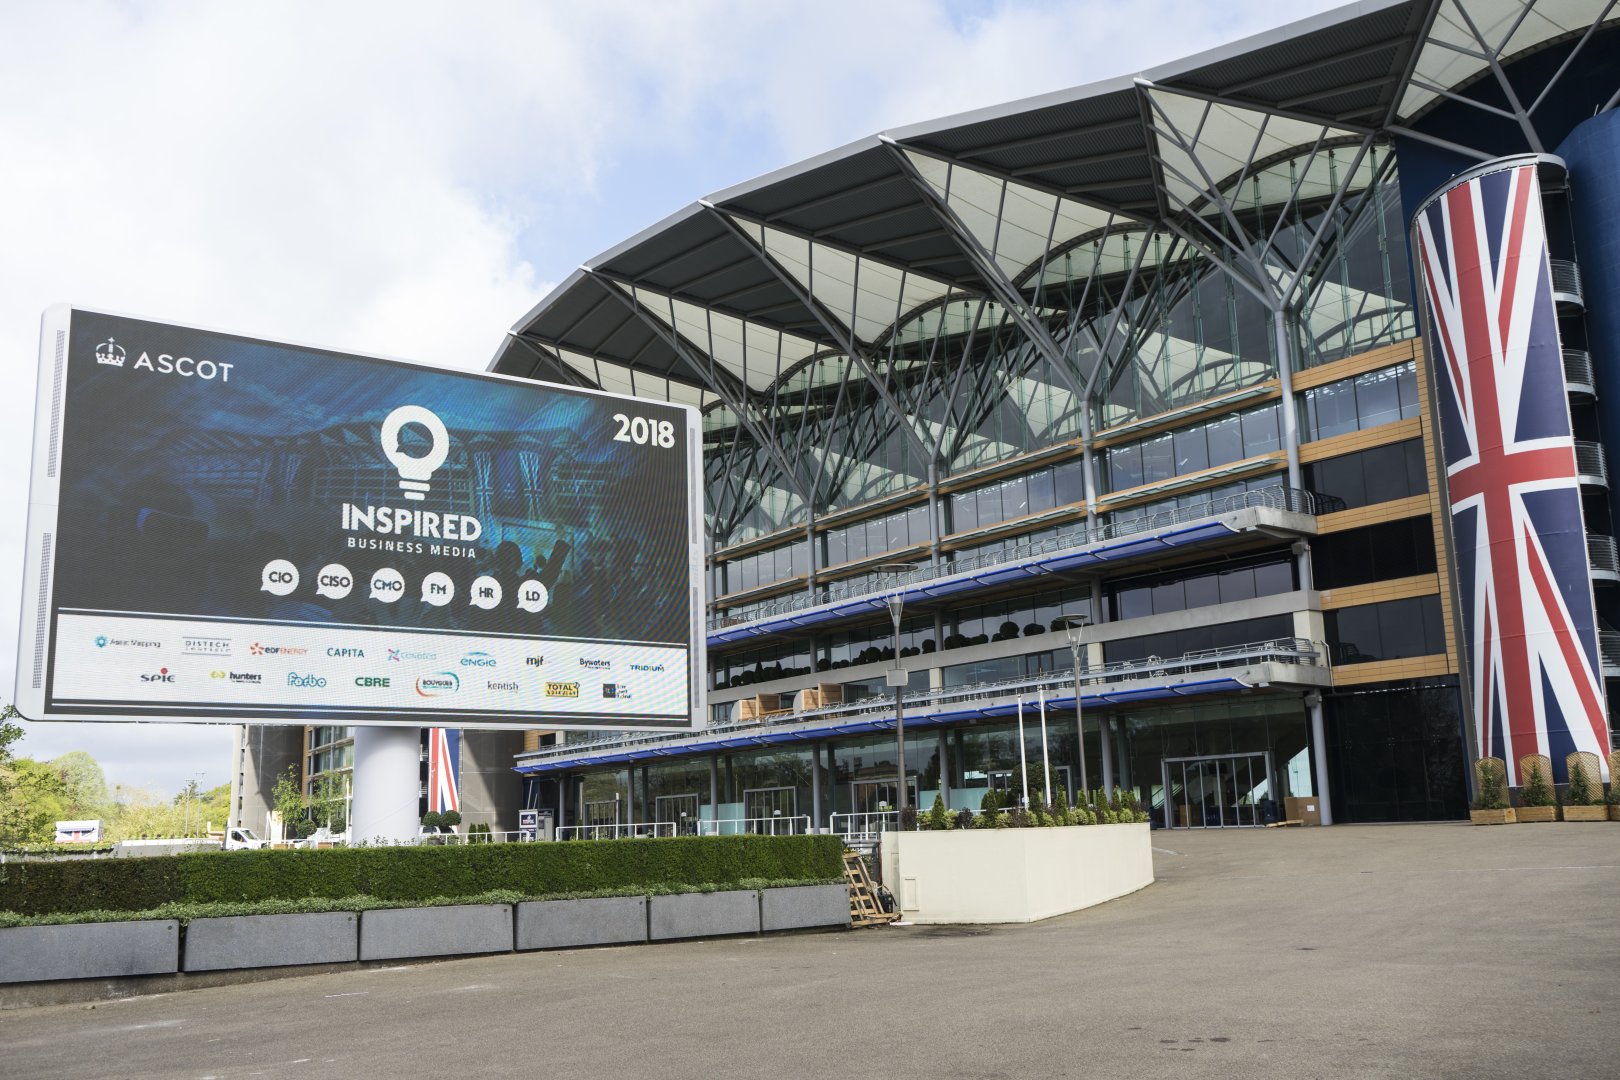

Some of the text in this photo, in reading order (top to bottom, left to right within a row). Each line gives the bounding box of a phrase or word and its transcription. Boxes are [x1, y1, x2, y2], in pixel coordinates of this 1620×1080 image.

[133, 351, 234, 382] ASCOT
[612, 413, 675, 449] 2018
[341, 502, 483, 542] INSPIRED
[347, 537, 477, 559] BUSINESS MEDIA
[268, 571, 293, 584] CIO
[320, 574, 351, 588] CISO
[373, 578, 403, 592] CMO
[430, 583, 447, 595] FM
[478, 586, 494, 598] HR
[525, 590, 541, 602] LD
[185, 640, 230, 648] DISTECH
[326, 647, 365, 658] CAPITA
[526, 655, 544, 667] mjf
[579, 658, 611, 667] Bywaters
[630, 663, 665, 672] TRIDIUM
[229, 671, 262, 680] hunters
[288, 671, 327, 688] Forbo
[355, 676, 391, 688] CBRE
[487, 680, 519, 691] kentish
[548, 683, 573, 691] TOTAL
